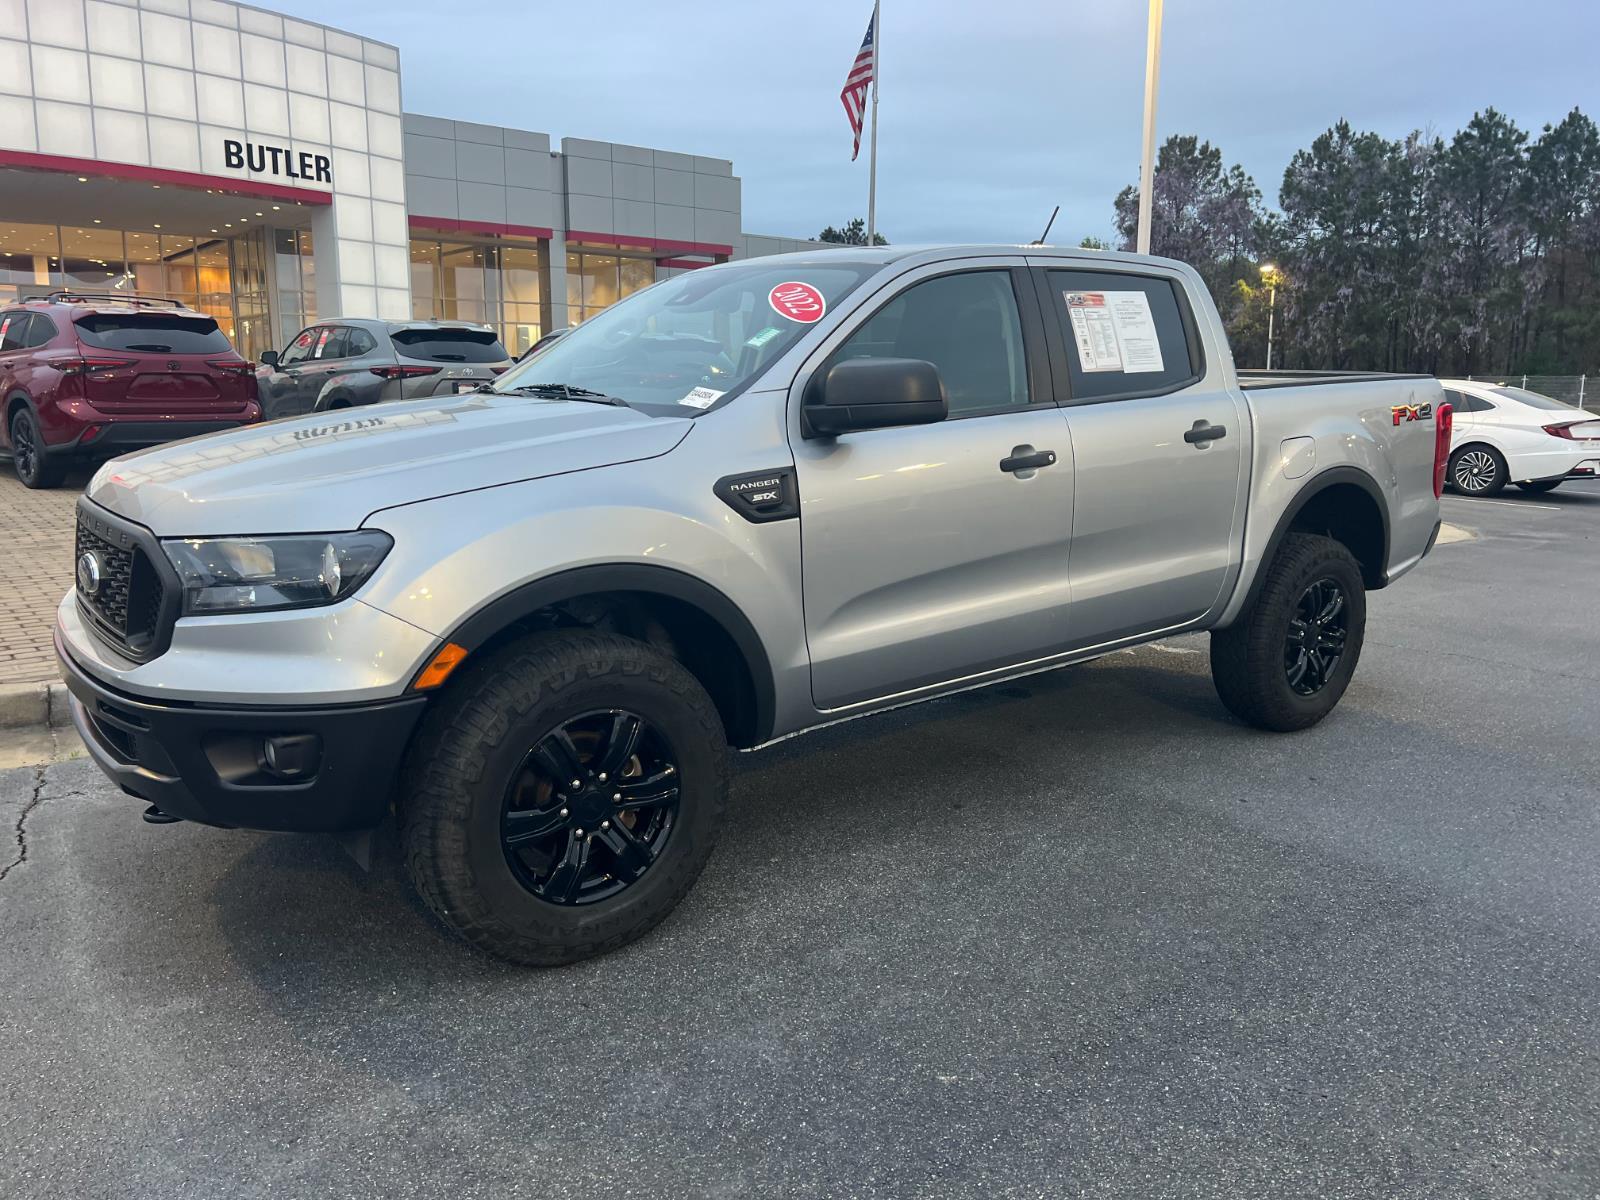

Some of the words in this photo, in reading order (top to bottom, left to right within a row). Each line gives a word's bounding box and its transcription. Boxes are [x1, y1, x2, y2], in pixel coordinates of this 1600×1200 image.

[224, 139, 332, 183] BUTLER
[774, 287, 820, 314] 2022
[1391, 402, 1432, 426] FX2
[730, 478, 780, 491] RANGER
[752, 491, 777, 502] STX
